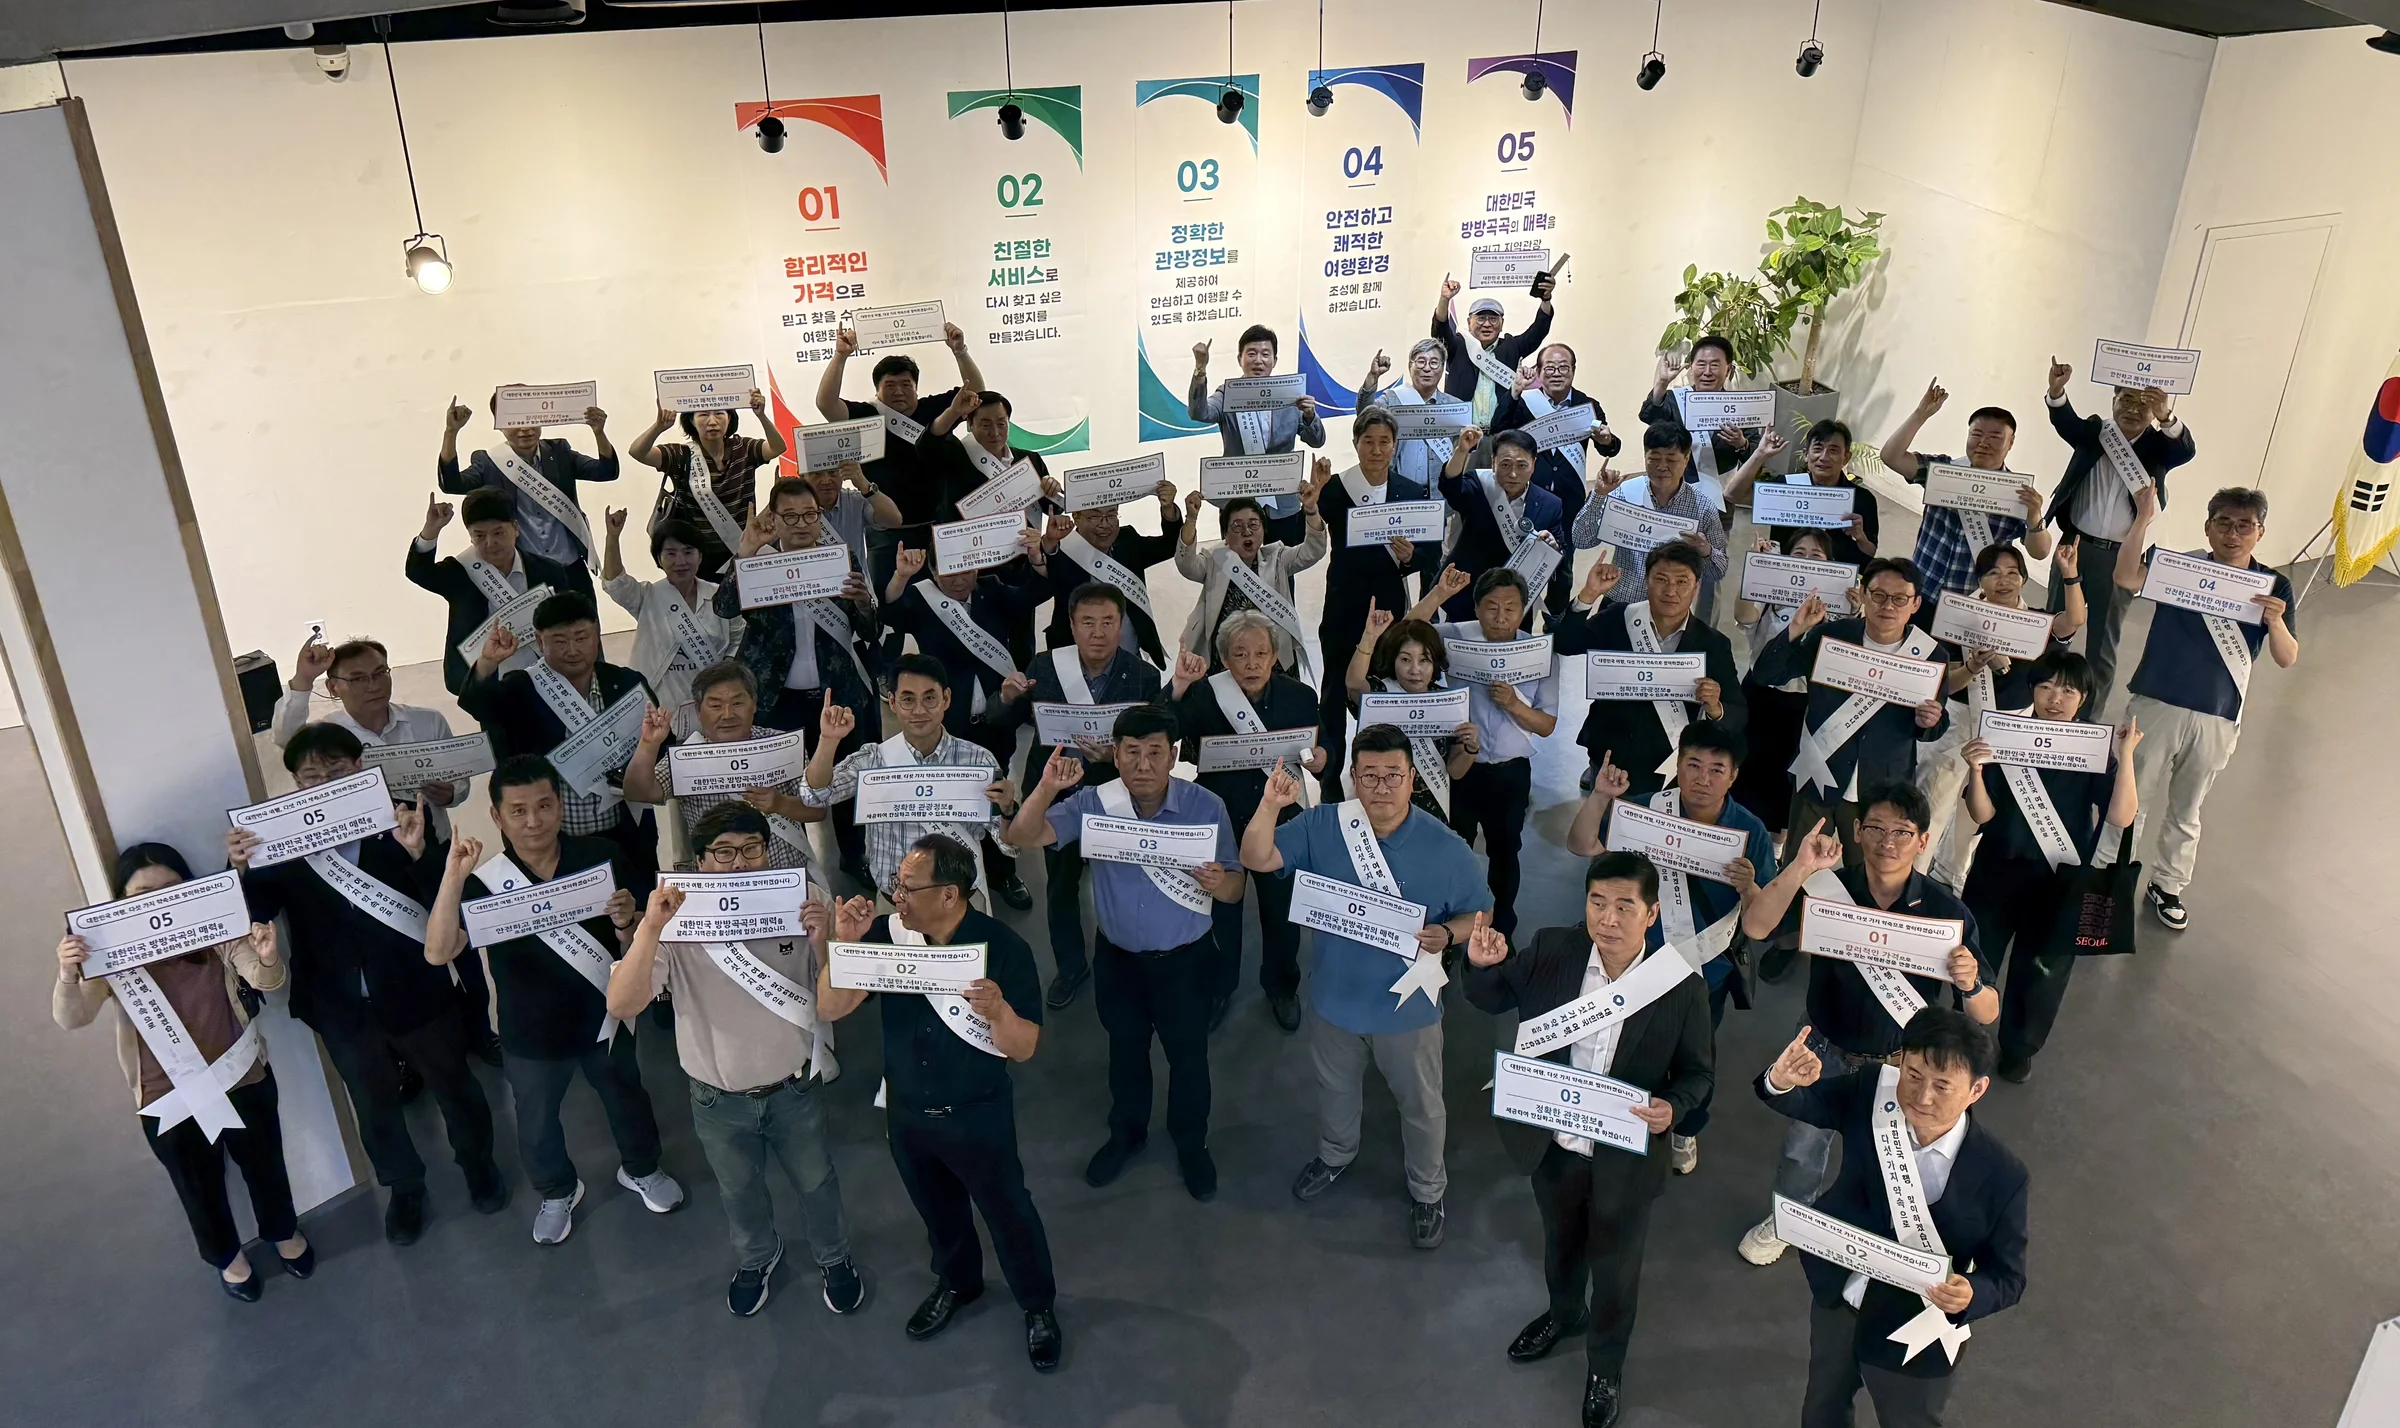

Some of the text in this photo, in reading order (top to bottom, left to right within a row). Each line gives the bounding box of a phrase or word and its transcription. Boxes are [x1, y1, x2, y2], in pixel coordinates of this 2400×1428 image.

[1497, 131, 1535, 163] 05
[1343, 145, 1383, 179] 04
[1177, 159, 1219, 192] 03
[997, 173, 1043, 208] 02
[798, 185, 840, 221] 01
[1486, 190, 1535, 212] 대한민국
[1326, 206, 1392, 230] 안전하고
[1171, 222, 1224, 244] 정확한
[1461, 213, 1556, 239] 방방곡곡의 매력을
[1333, 231, 1383, 252] 쾌적한
[993, 238, 1051, 261] 친절한
[783, 251, 868, 278] 합리적인
[1155, 247, 1238, 271] 관광정보를
[1324, 254, 1390, 278] 여행환경
[1504, 263, 1516, 272] 05
[988, 265, 1059, 287] 서비스로
[1175, 274, 1218, 289] 제공하여
[793, 281, 866, 303] 가격으로
[1329, 281, 1383, 297] 조성에 함께
[986, 290, 1061, 308] 다시 찾고 싶은
[1151, 289, 1242, 309] 안심하고 여행할 수
[1328, 298, 1381, 313] 하겠습니다.
[782, 313, 808, 327] 믿고
[811, 310, 836, 324] 찾을
[840, 309, 852, 321] 수
[1002, 310, 1048, 325] 여행지를
[1151, 306, 1242, 326] 있도록 하겠습니다.
[893, 318, 906, 329] 02
[989, 326, 1061, 344] 만들겠습니다.
[2136, 361, 2152, 373] 04
[699, 383, 714, 393] 04
[1259, 388, 1272, 398] 03
[541, 400, 554, 411] 01
[1723, 404, 1737, 414] 05
[1423, 417, 1436, 426] 02
[1548, 424, 1559, 434] 01
[837, 437, 851, 449] 02
[1244, 469, 1259, 479] 02
[1108, 478, 1123, 489] 02
[1971, 483, 1986, 495] 02
[994, 491, 1006, 504] 01
[1795, 500, 1810, 510] 03
[1388, 515, 1403, 526] 04
[1638, 523, 1653, 536] 04
[972, 535, 983, 547] 01
[786, 567, 801, 580] 01
[1790, 575, 1806, 587] 03
[2198, 578, 2216, 591] 04
[772, 582, 820, 595] 합리적인 가격으로
[2164, 586, 2192, 599] 안전하고
[2214, 598, 2242, 612] 여행환경
[1982, 619, 1997, 633] 01
[668, 663, 686, 671] CITY
[1490, 658, 1506, 669] 03
[1637, 670, 1653, 682] 03
[1868, 667, 1884, 680] 01
[1409, 709, 1425, 720] 03
[1083, 720, 1098, 731] 01
[602, 731, 619, 747] 02
[2034, 737, 2052, 749] 05
[1249, 746, 1264, 756] 01
[1996, 750, 2026, 758] 대한민국
[414, 757, 434, 769] 02
[730, 758, 749, 771] 05
[915, 785, 934, 798] 03
[893, 803, 954, 812] 정확한 관광정보를
[303, 808, 325, 826] 05
[267, 837, 302, 852] 대한민국
[304, 823, 348, 842] 방방곡곡의
[1139, 838, 1158, 850] 03
[1665, 834, 1682, 849] 01
[531, 900, 553, 914] 04
[719, 896, 740, 912] 05
[1348, 902, 1367, 917] 05
[149, 911, 173, 930] 05
[680, 916, 783, 930] 대한민국 방방곡곡의 매력을
[1310, 909, 1399, 941] 대한민국 방방곡곡의 매력을
[107, 922, 224, 959] 대한민국 방방곡곡의 매력을
[1868, 931, 1888, 946] 01
[2075, 936, 2108, 947] SEOUL
[1845, 943, 1912, 962] 합리적인 가격으로
[896, 963, 917, 975] 02
[1510, 1063, 1532, 1073] 대한민국
[1560, 1088, 1581, 1105] 03
[1535, 1104, 1603, 1128] 정확한 관광정보를
[1890, 1120, 1905, 1160] 대한민국
[1900, 1163, 1914, 1188] 여행,
[1881, 1133, 1910, 1229] 다섯 가지 약속으로
[1846, 1244, 1868, 1262] 02
